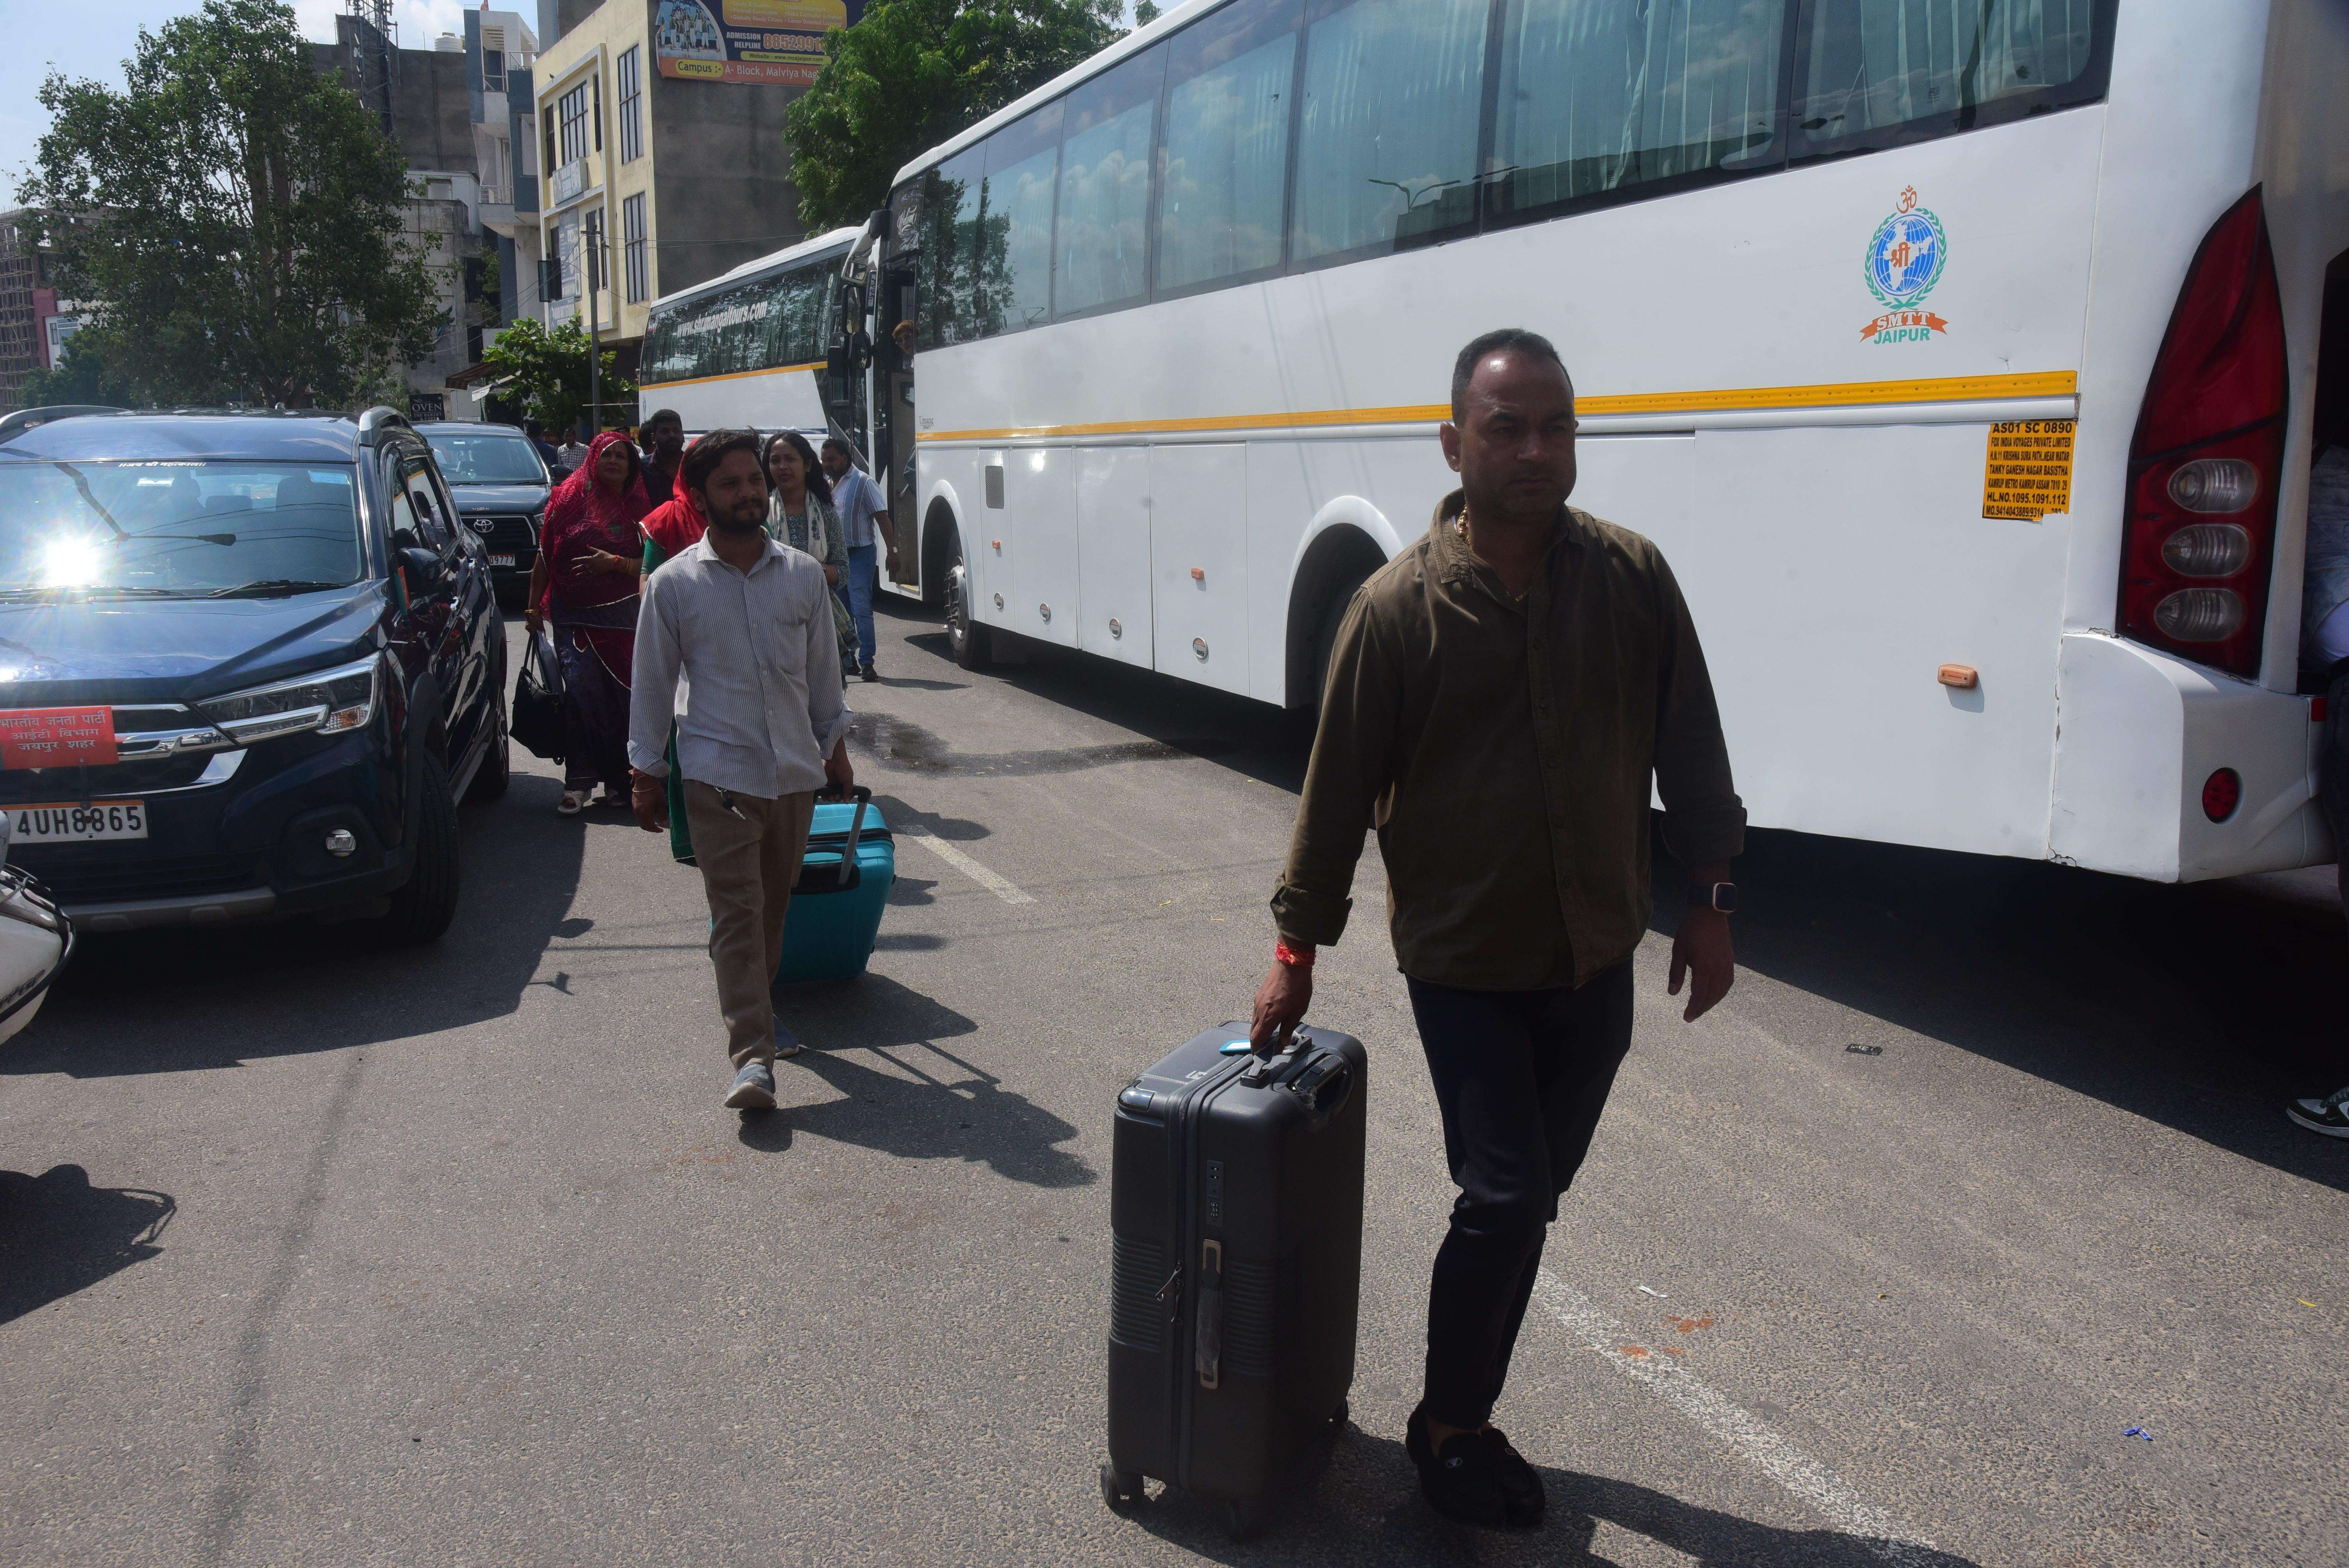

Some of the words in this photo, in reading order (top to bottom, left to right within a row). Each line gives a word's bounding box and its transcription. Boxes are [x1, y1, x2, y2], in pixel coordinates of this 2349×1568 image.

[727, 32, 761, 40] ADMISSION
[734, 41, 761, 49] HELPLINE
[678, 61, 712, 74] Campus
[737, 65, 763, 77] Block,
[766, 67, 798, 79] Malviya
[802, 69, 817, 79] Nag
[1891, 242, 1911, 267] श्री
[677, 300, 768, 338] www.shrimangaltours.com
[1877, 312, 1930, 331] SMTT
[1874, 328, 1930, 345] JAIPUR
[412, 403, 442, 412] OVEN
[919, 416, 934, 426] Umang
[1993, 423, 2020, 433] AS01
[2025, 423, 2040, 433] SC
[2044, 422, 2072, 433] 0890
[2000, 437, 2012, 447] INDIA
[2013, 437, 2032, 447] VOYAGES
[2034, 437, 2051, 447] PRIVATE
[2053, 437, 2071, 447] LIMITED
[2003, 451, 2019, 461] KRISHNA
[2021, 451, 2031, 461] SURA
[2056, 451, 2069, 461] WATAR
[1990, 465, 2005, 474] TANKY
[2006, 465, 2025, 475] GANESH
[2026, 465, 2042, 476] NAGAR
[2044, 465, 2068, 476] BASISTHA
[1988, 478, 2003, 488] KAMRUP
[2005, 479, 2018, 489] METRO
[2019, 479, 2035, 489] KAMRUP
[2035, 479, 2049, 490] ASSAM
[490, 556, 514, 564] 09777
[0, 714, 40, 728] भारतीय
[45, 716, 76, 726] जनता
[81, 710, 106, 724] पार्टी
[11, 728, 51, 741] आईटी
[58, 728, 99, 738] विभाग
[18, 741, 59, 753] जयपुर
[66, 739, 96, 750] शहर
[4, 806, 142, 836] 4UH8865
